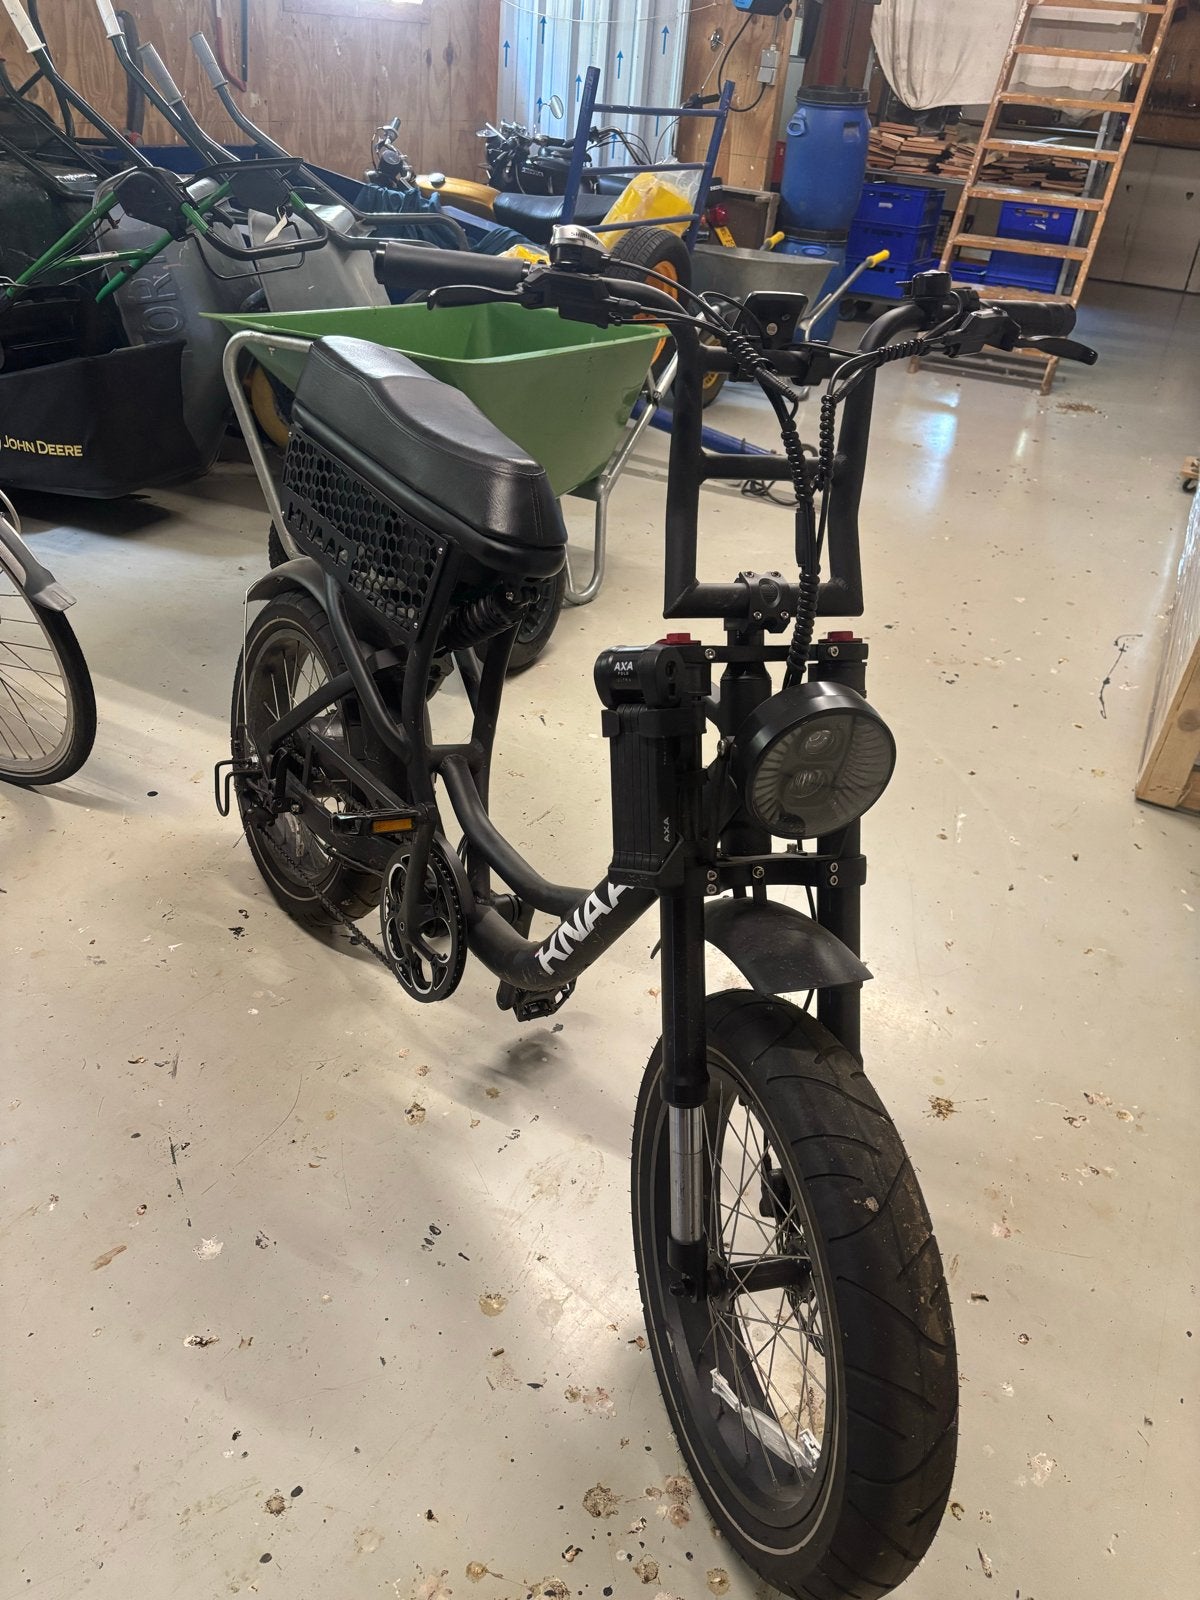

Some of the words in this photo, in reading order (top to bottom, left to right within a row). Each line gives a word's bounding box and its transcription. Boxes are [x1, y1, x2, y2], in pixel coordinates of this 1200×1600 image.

[3, 434, 36, 454] JOHN
[36, 440, 83, 457] DEERE
[613, 661, 634, 671] AXA
[534, 881, 635, 976] KNAA
